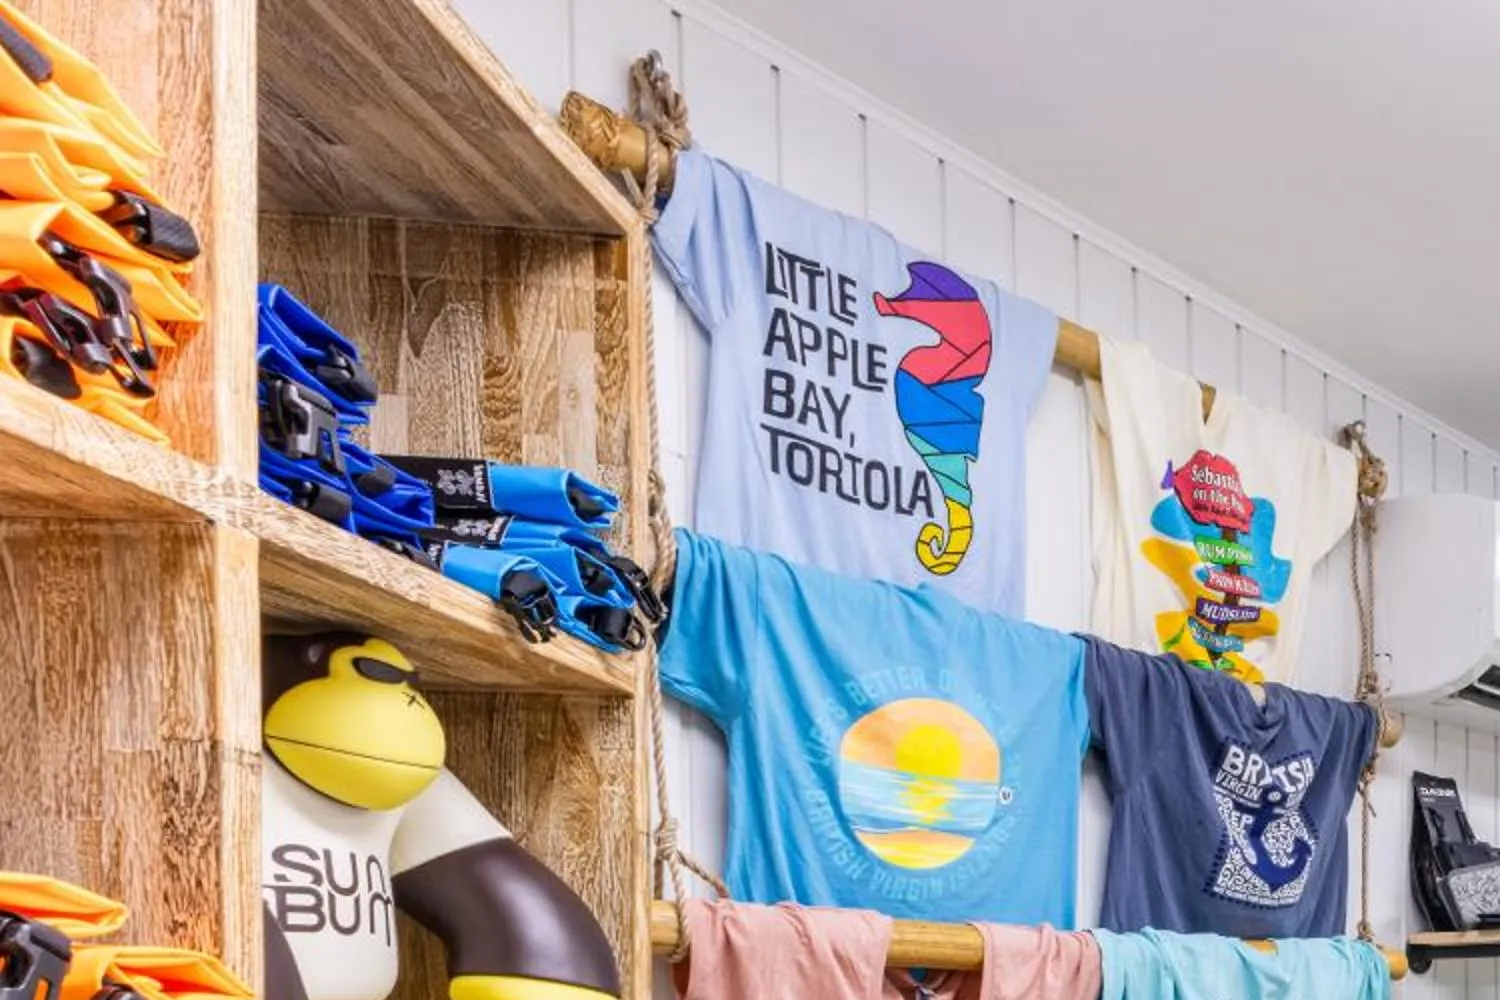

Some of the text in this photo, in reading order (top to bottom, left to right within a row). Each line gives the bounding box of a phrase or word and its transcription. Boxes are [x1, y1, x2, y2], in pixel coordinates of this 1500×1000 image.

[765, 241, 858, 326] LITTLE
[763, 307, 888, 392] APPLE
[763, 368, 856, 448] BAY,
[760, 423, 935, 518] TORTOLA
